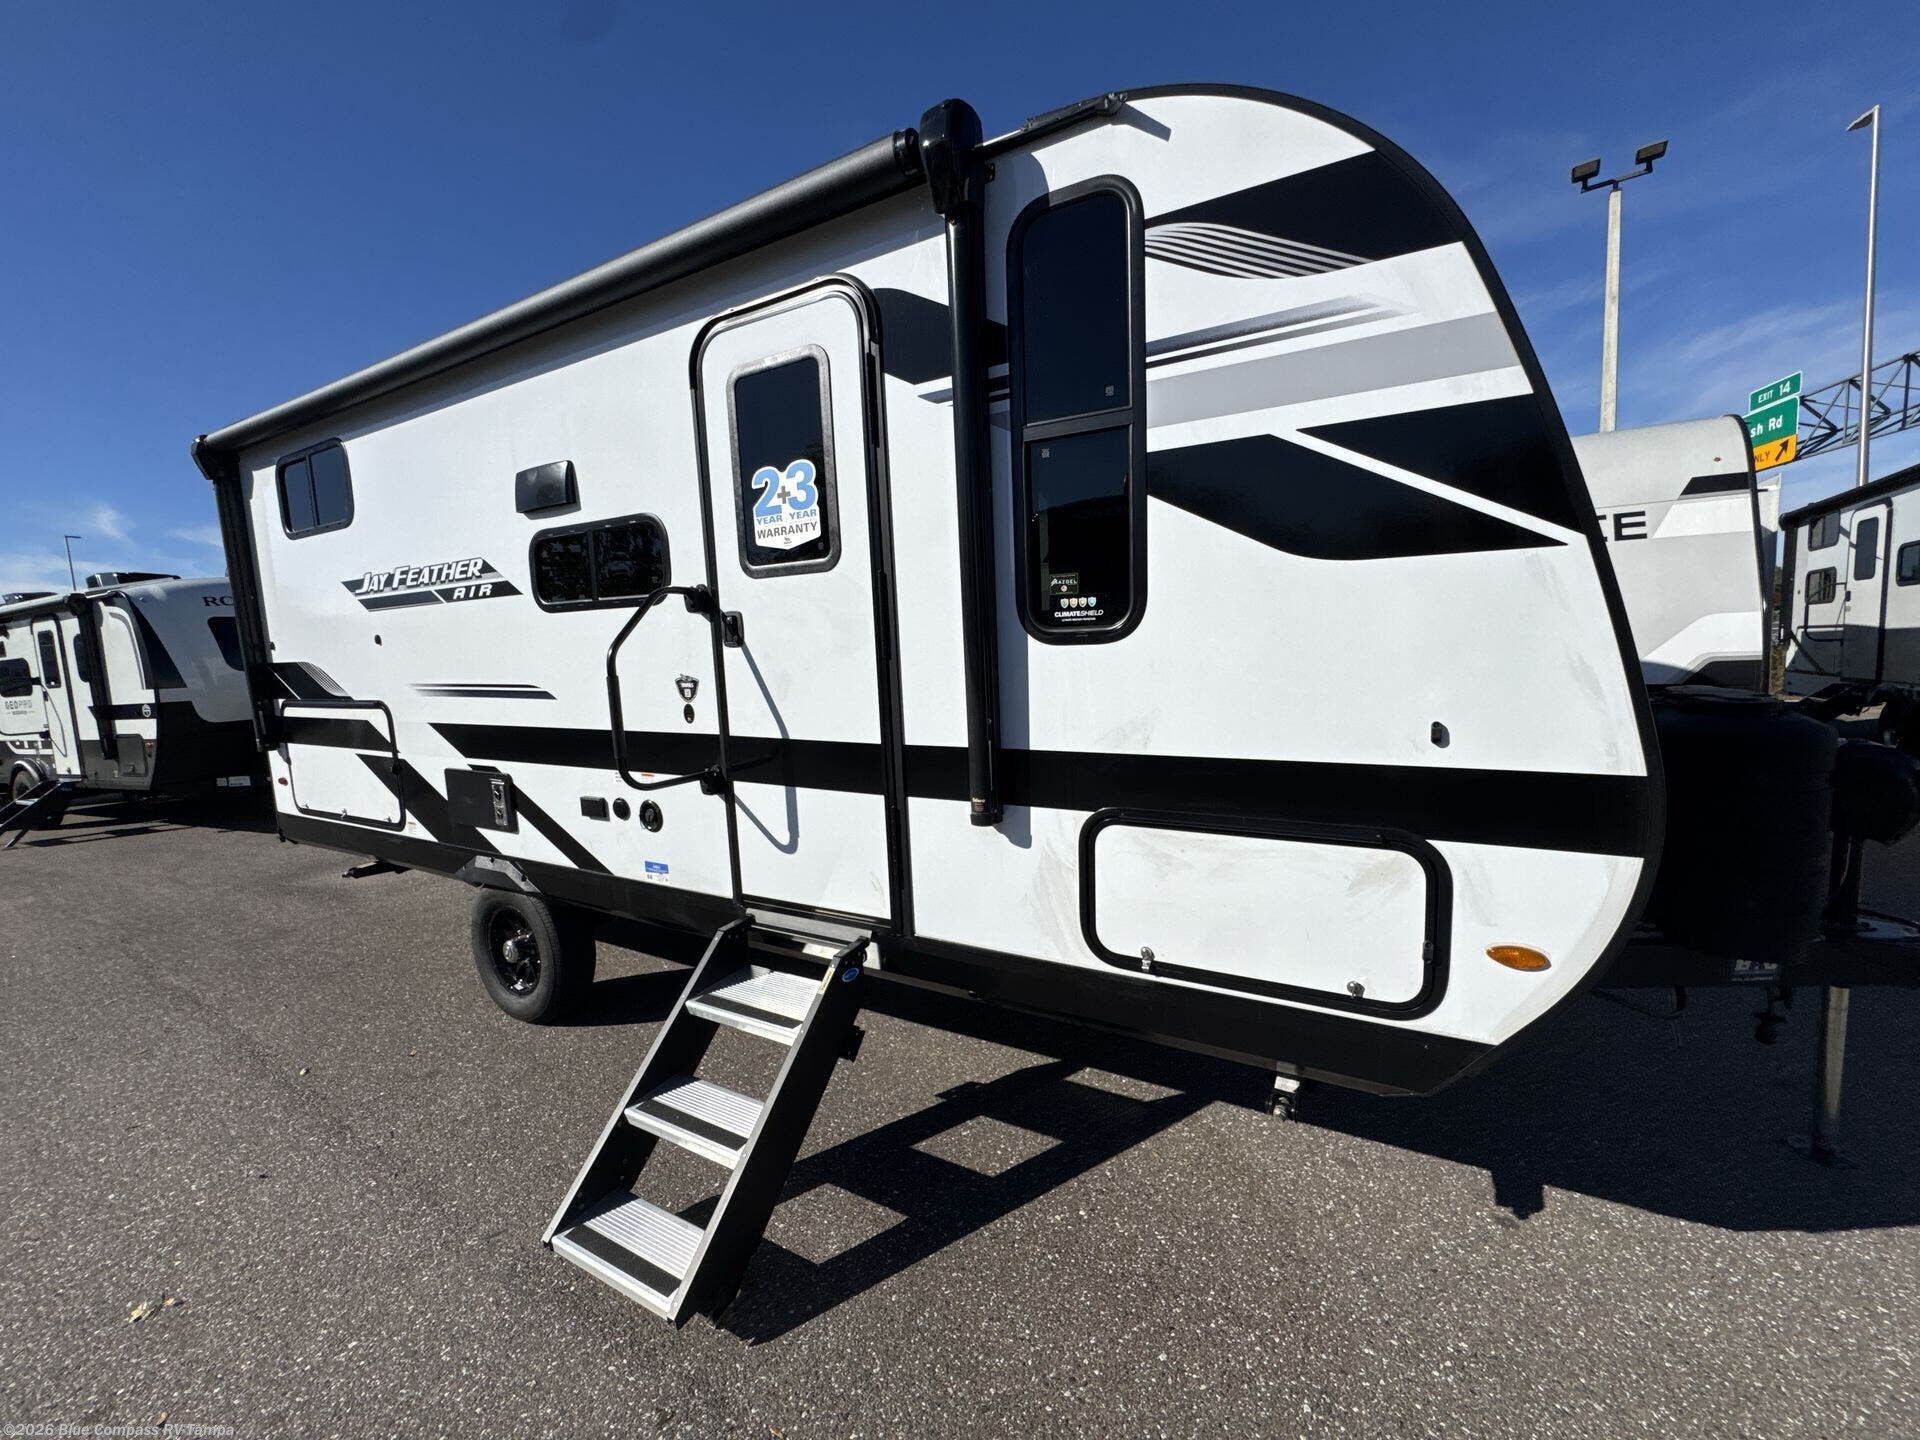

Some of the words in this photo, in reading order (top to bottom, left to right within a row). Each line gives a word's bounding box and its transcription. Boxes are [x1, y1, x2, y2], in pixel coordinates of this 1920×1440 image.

[1758, 389, 1774, 403] EXIT
[1779, 381, 1791, 395] 14
[1768, 415, 1783, 431] Rd
[757, 515, 783, 525] YEAR
[789, 509, 817, 520] YEAR
[757, 521, 818, 539] WARRANTY
[355, 572, 389, 595] JAY
[391, 558, 485, 591] FEATHER
[452, 584, 493, 600] AIR
